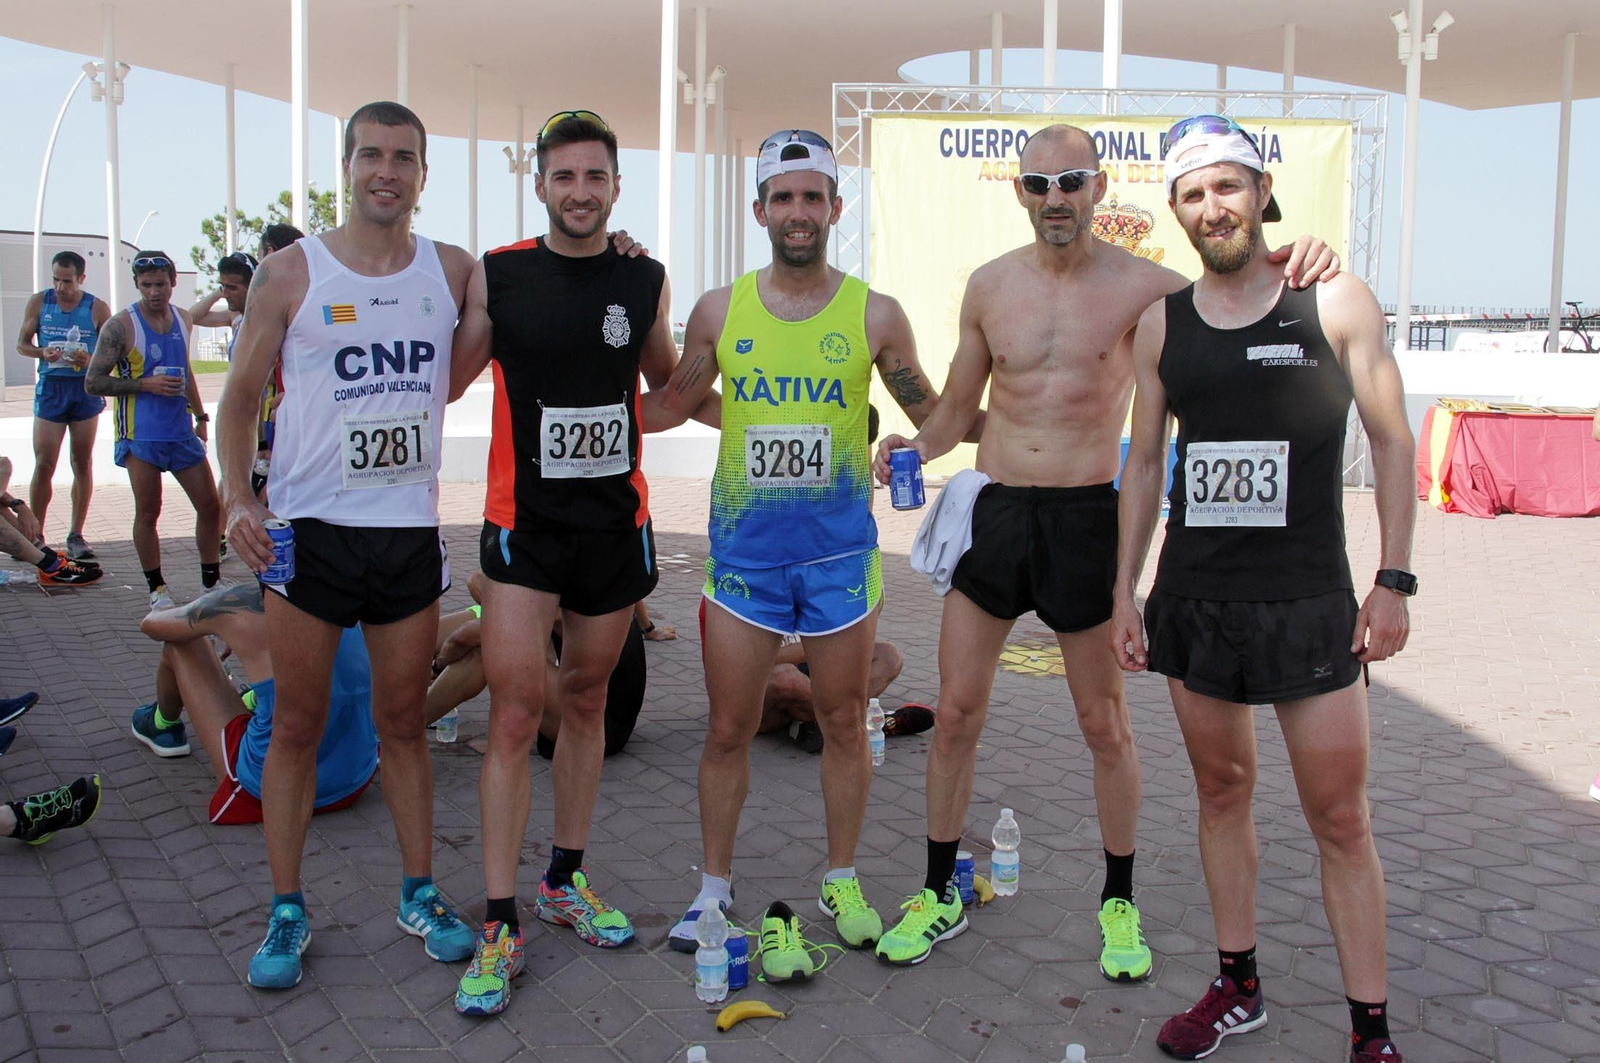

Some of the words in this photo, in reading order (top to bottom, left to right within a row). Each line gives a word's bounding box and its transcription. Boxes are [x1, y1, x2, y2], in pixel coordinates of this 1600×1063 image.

[939, 128, 1030, 158] CUERPO
[334, 340, 435, 381] CNP
[334, 382, 385, 402] COMUNIDAD
[386, 380, 431, 394] VALENCIANA
[730, 367, 847, 409] XÀTIVA
[349, 424, 422, 470] 3281
[549, 419, 623, 460] 3282
[396, 464, 432, 475] DEPORTIVA
[593, 457, 628, 467] DEPORTIVA
[751, 438, 824, 478] 3284
[791, 479, 829, 487] DEPORTIVA
[1192, 458, 1278, 504] 3283
[1237, 505, 1283, 514] DEPORTIVA
